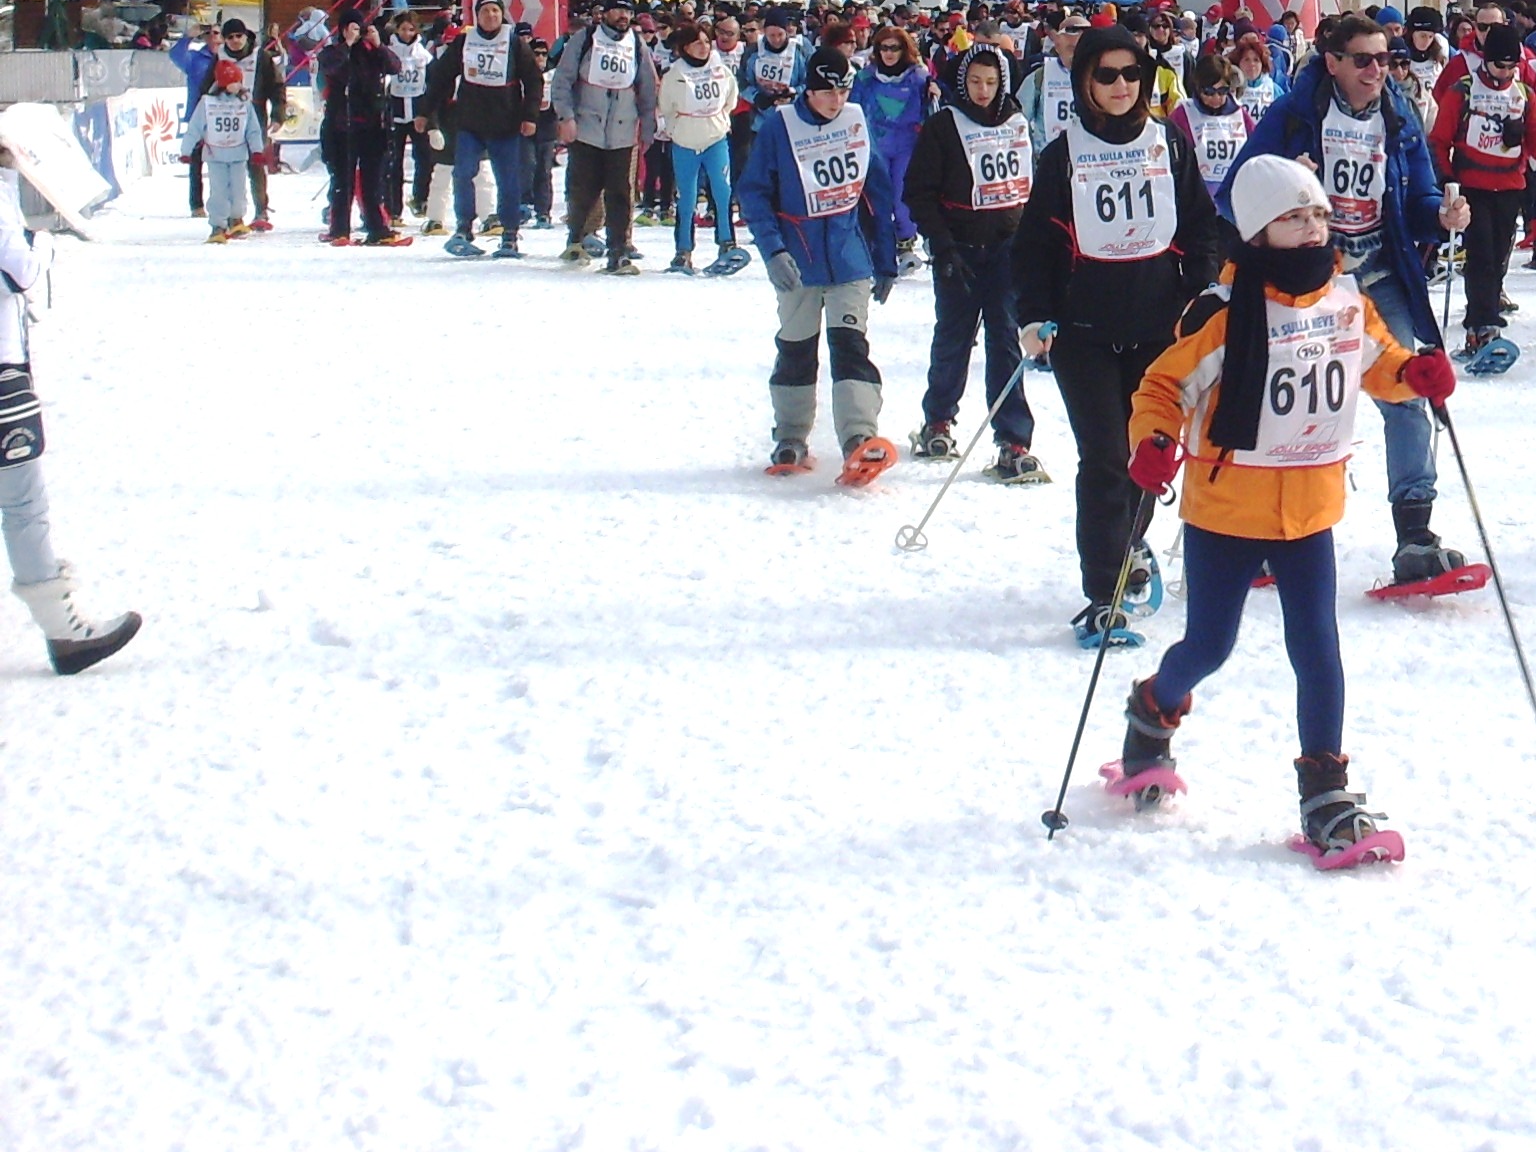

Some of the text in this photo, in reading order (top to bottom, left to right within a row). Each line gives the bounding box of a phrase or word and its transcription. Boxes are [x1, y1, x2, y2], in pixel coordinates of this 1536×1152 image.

[477, 54, 495, 70] 97
[600, 55, 627, 74] 660
[761, 64, 783, 81] 651
[694, 81, 720, 99] 680
[215, 117, 240, 132] 598
[1207, 141, 1237, 160] 697
[813, 152, 859, 187] 605
[980, 150, 1020, 182] 666
[1095, 179, 1155, 223] 611
[1270, 359, 1345, 416] 610
